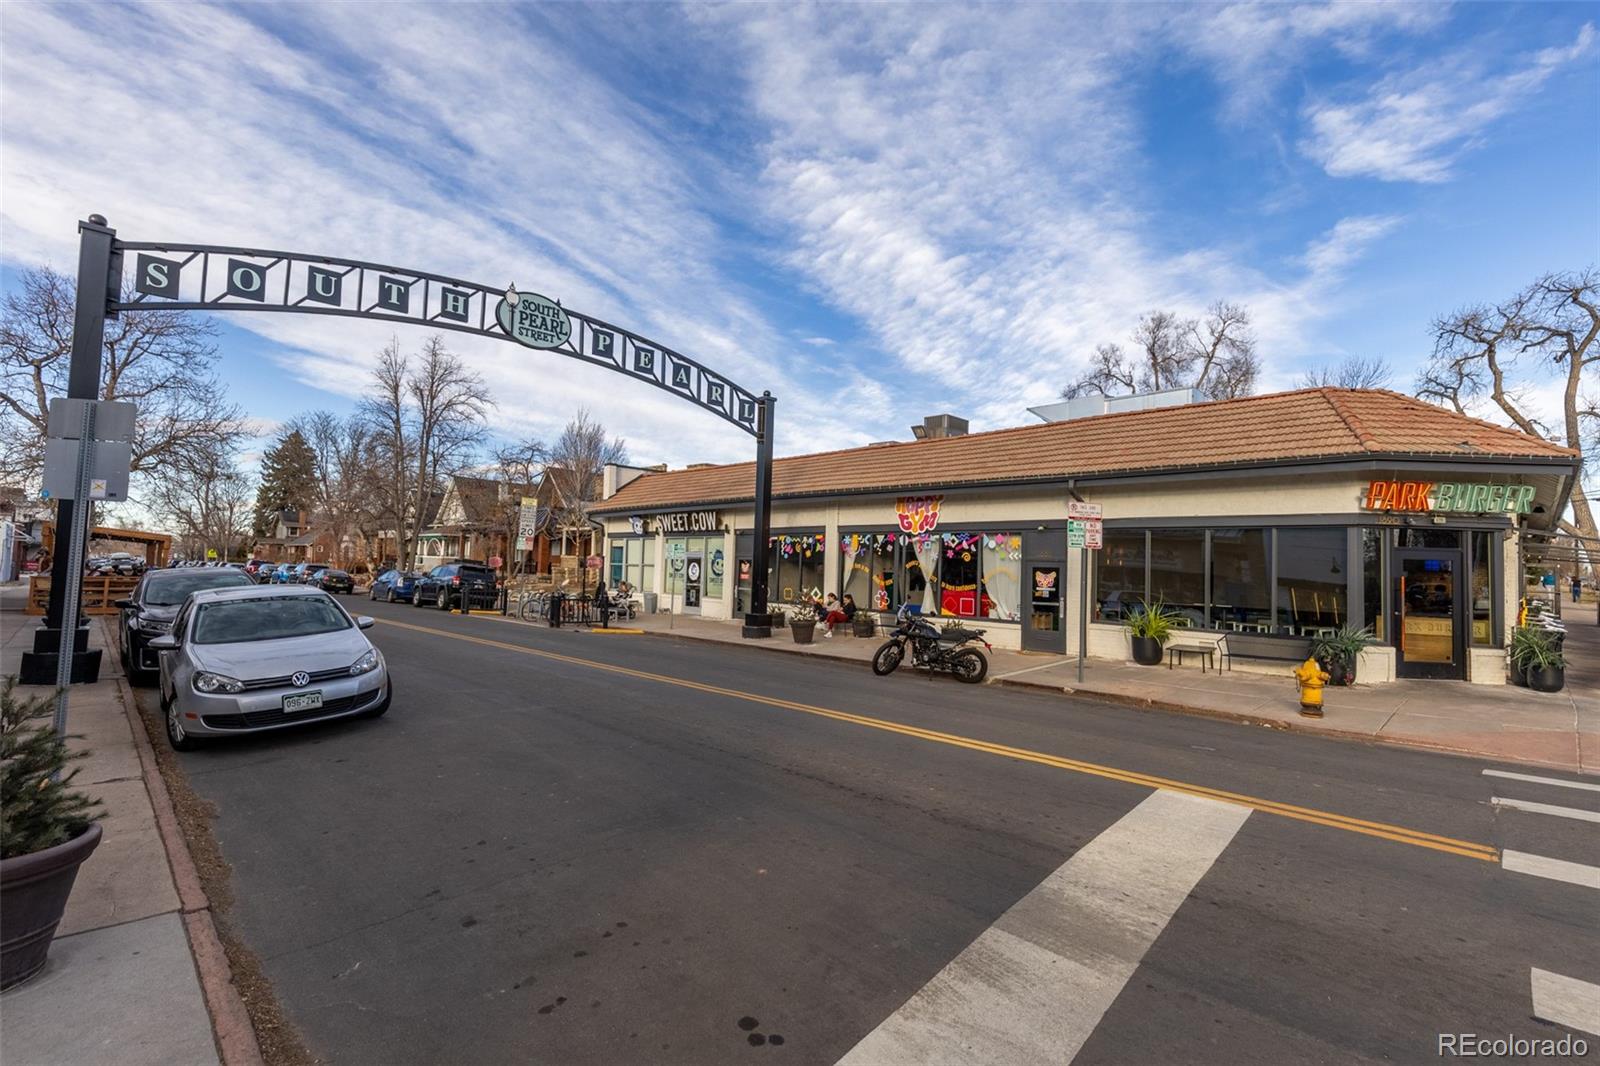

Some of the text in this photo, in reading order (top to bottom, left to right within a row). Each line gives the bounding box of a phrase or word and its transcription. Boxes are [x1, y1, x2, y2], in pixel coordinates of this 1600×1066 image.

[522, 299, 561, 320] SOUTH
[518, 311, 568, 341] PEARL
[518, 326, 556, 343] STREET
[145, 262, 754, 418] SOUTH PEARL
[1366, 480, 1537, 513] PARK BURGER
[520, 527, 534, 535] 20
[656, 511, 717, 532] SWEET COW
[898, 509, 938, 533] GYM
